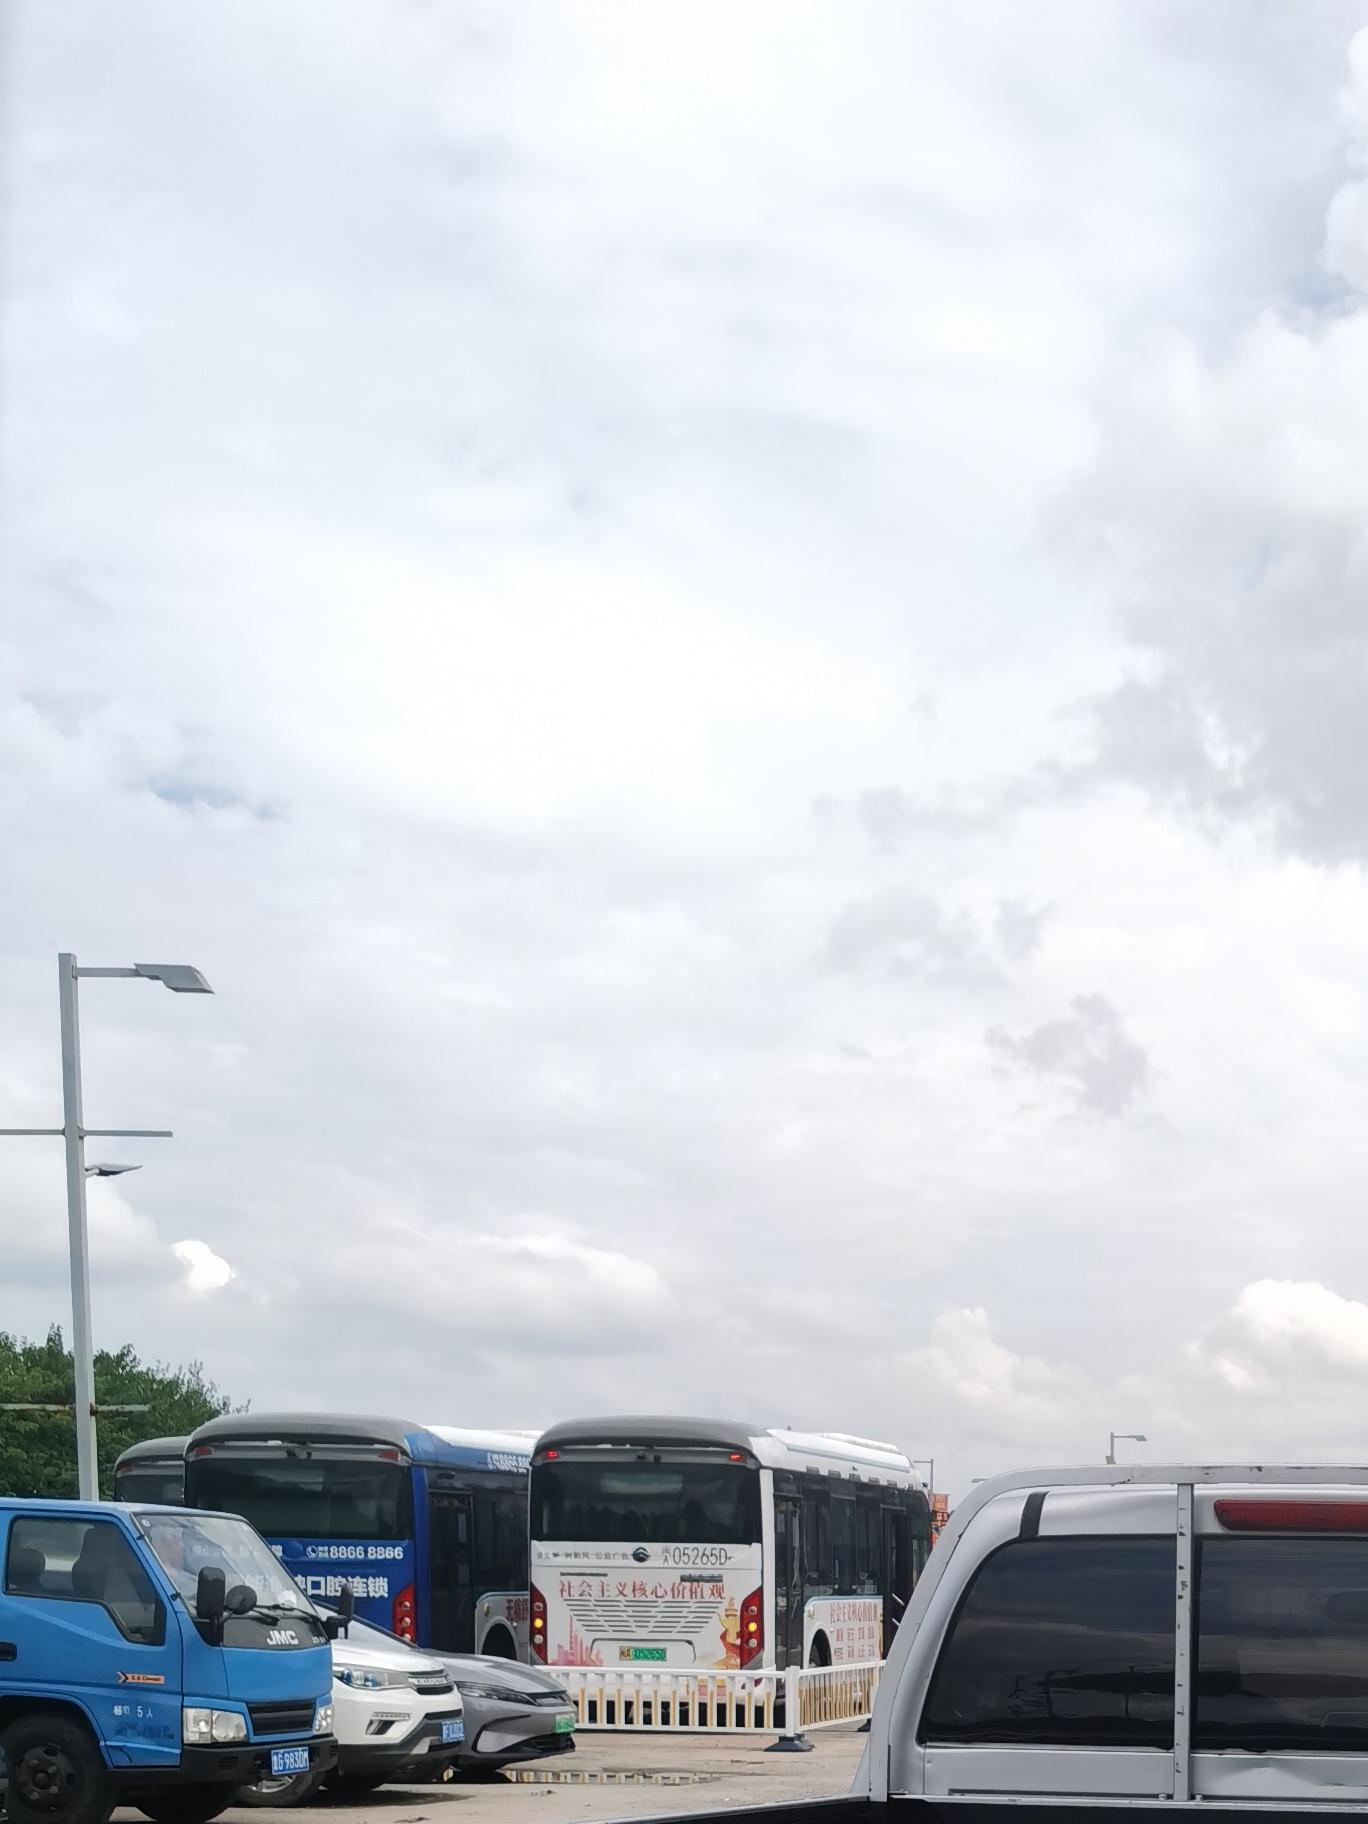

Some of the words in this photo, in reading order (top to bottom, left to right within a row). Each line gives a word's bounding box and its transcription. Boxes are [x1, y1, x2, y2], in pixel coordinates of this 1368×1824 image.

[329, 1545, 365, 1559] 8866
[367, 1546, 403, 1560] 8866
[559, 1579, 726, 1600] 社会主义核心价值观
[266, 1629, 299, 1645] JMC
